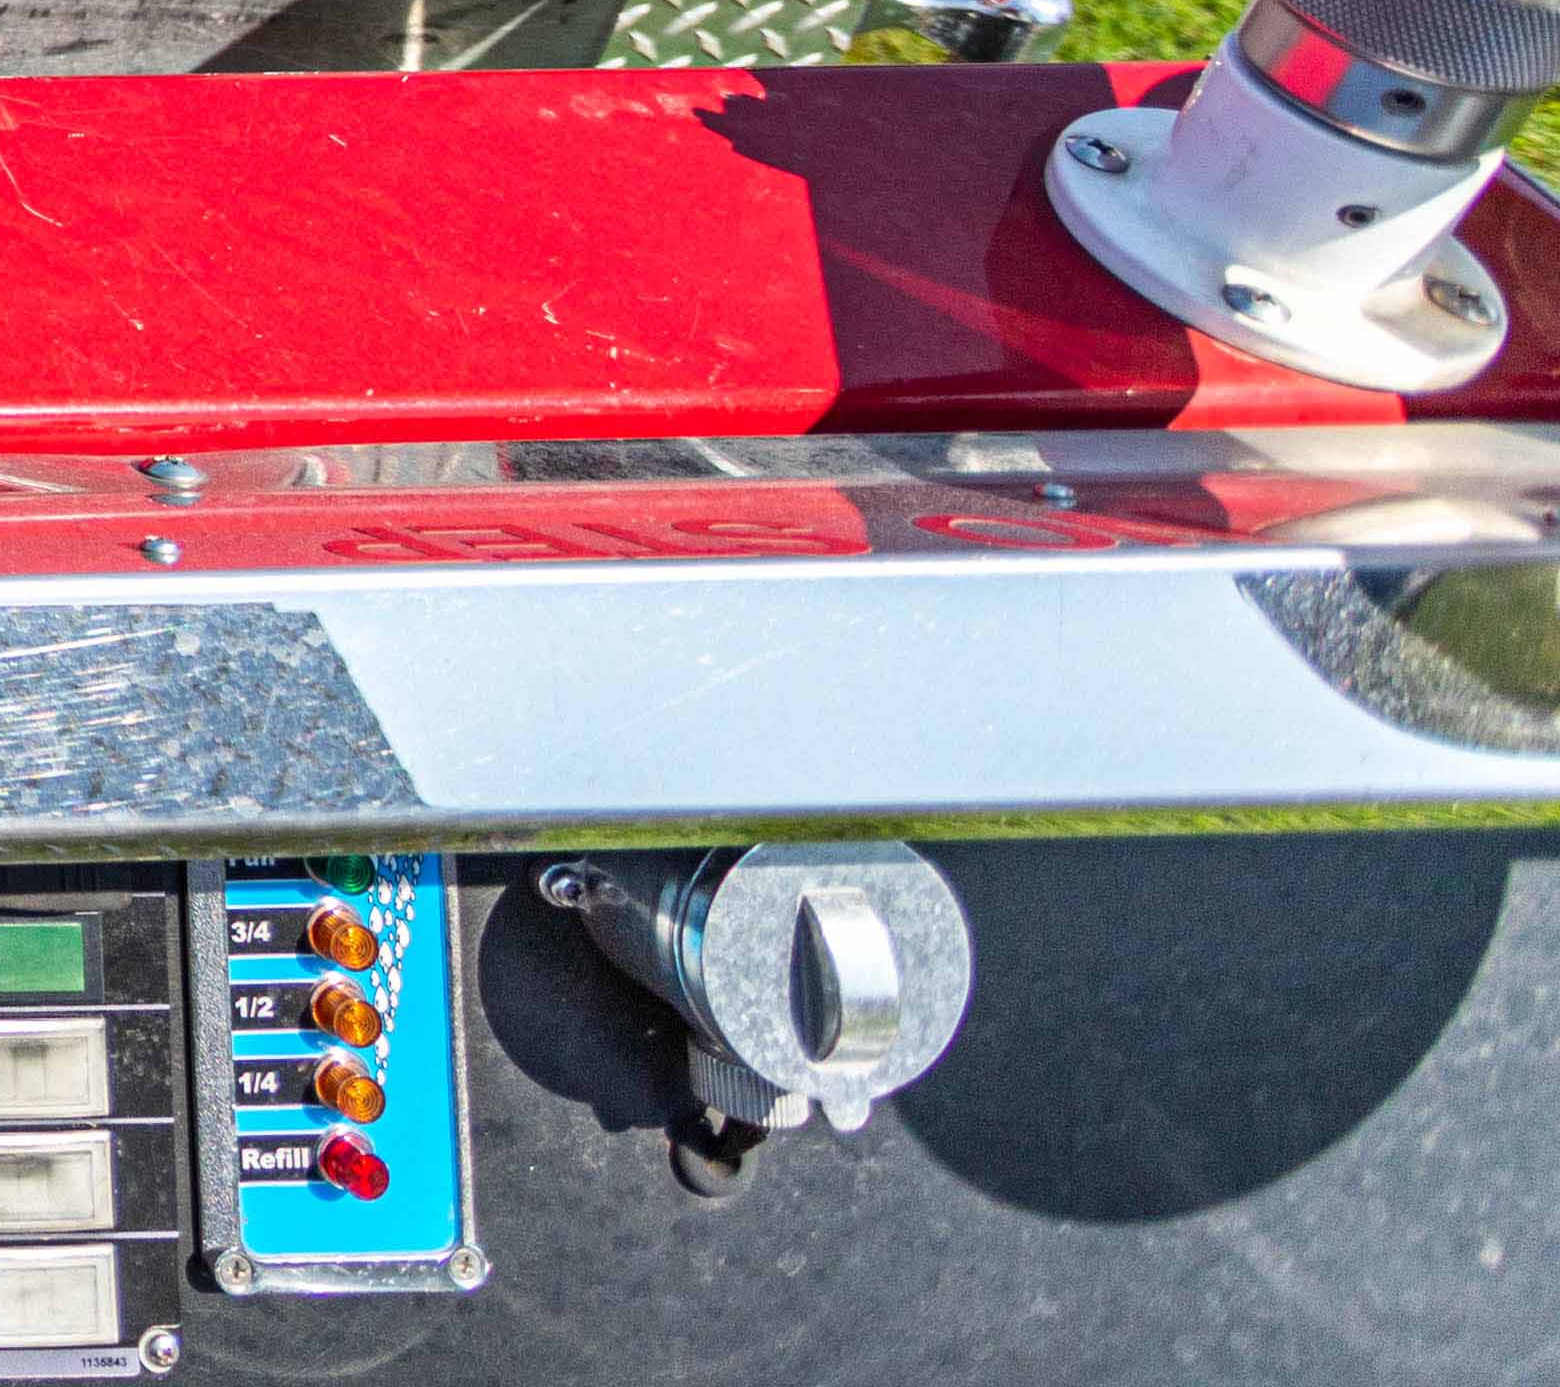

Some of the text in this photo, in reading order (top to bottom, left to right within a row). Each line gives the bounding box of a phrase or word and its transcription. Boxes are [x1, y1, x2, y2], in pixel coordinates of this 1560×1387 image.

[320, 520, 873, 563] STEP
[231, 921, 271, 943] 3/4
[233, 996, 274, 1018] 1/2
[238, 1072, 280, 1094] 1/4
[241, 1147, 310, 1170] Refill
